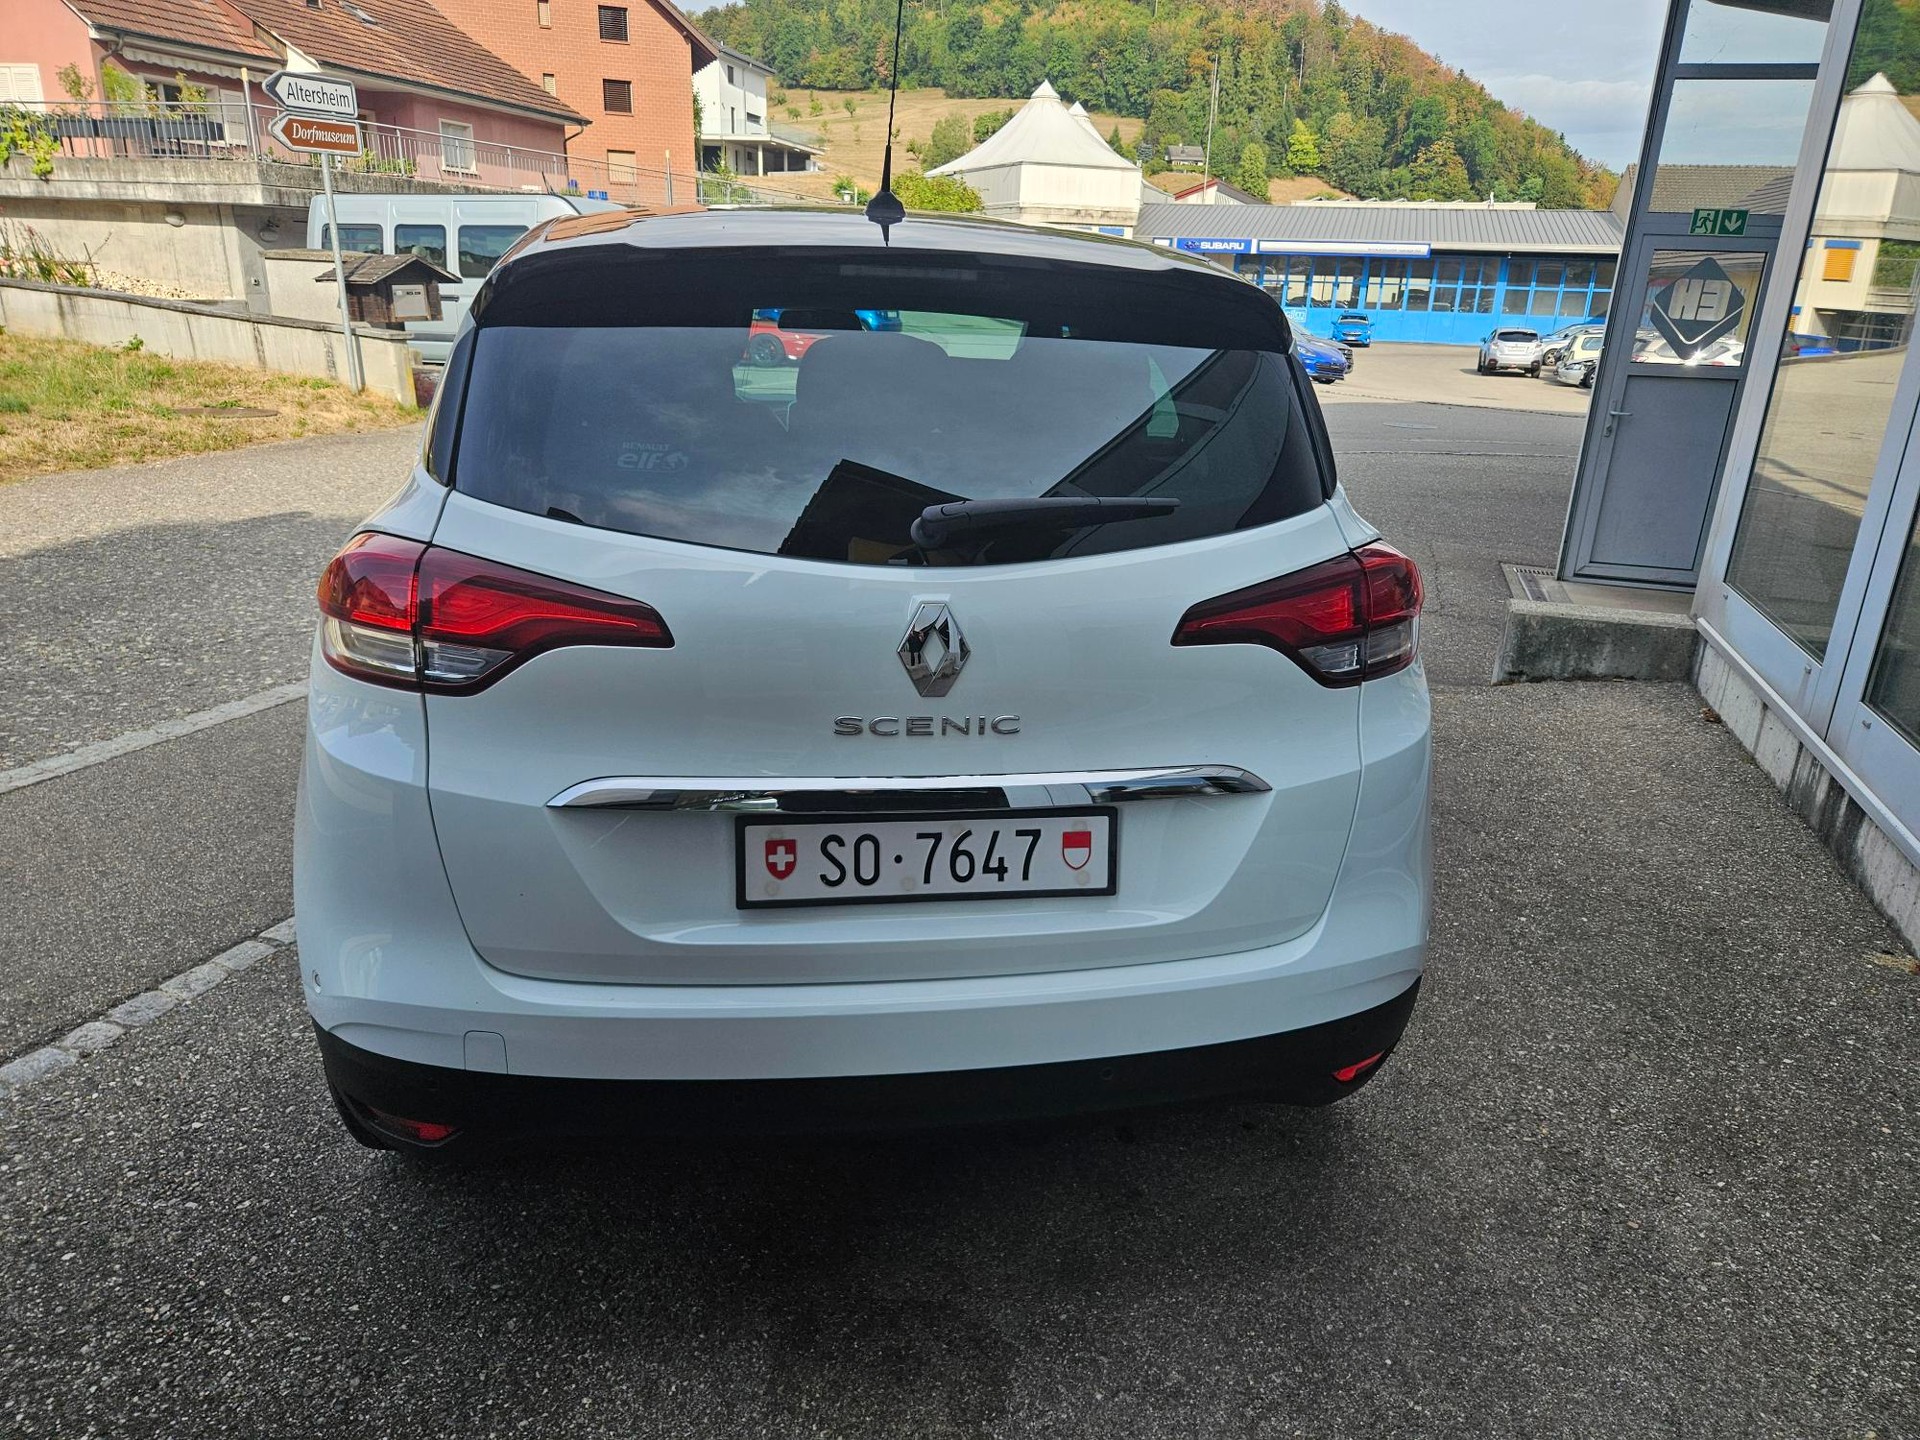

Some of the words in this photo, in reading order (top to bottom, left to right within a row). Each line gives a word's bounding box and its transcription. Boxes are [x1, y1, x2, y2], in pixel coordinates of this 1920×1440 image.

[287, 82, 350, 108] Altersheim
[292, 122, 355, 144] Dorfmuseum
[1200, 241, 1244, 250] SUBARU
[833, 715, 1021, 736] SCENIC
